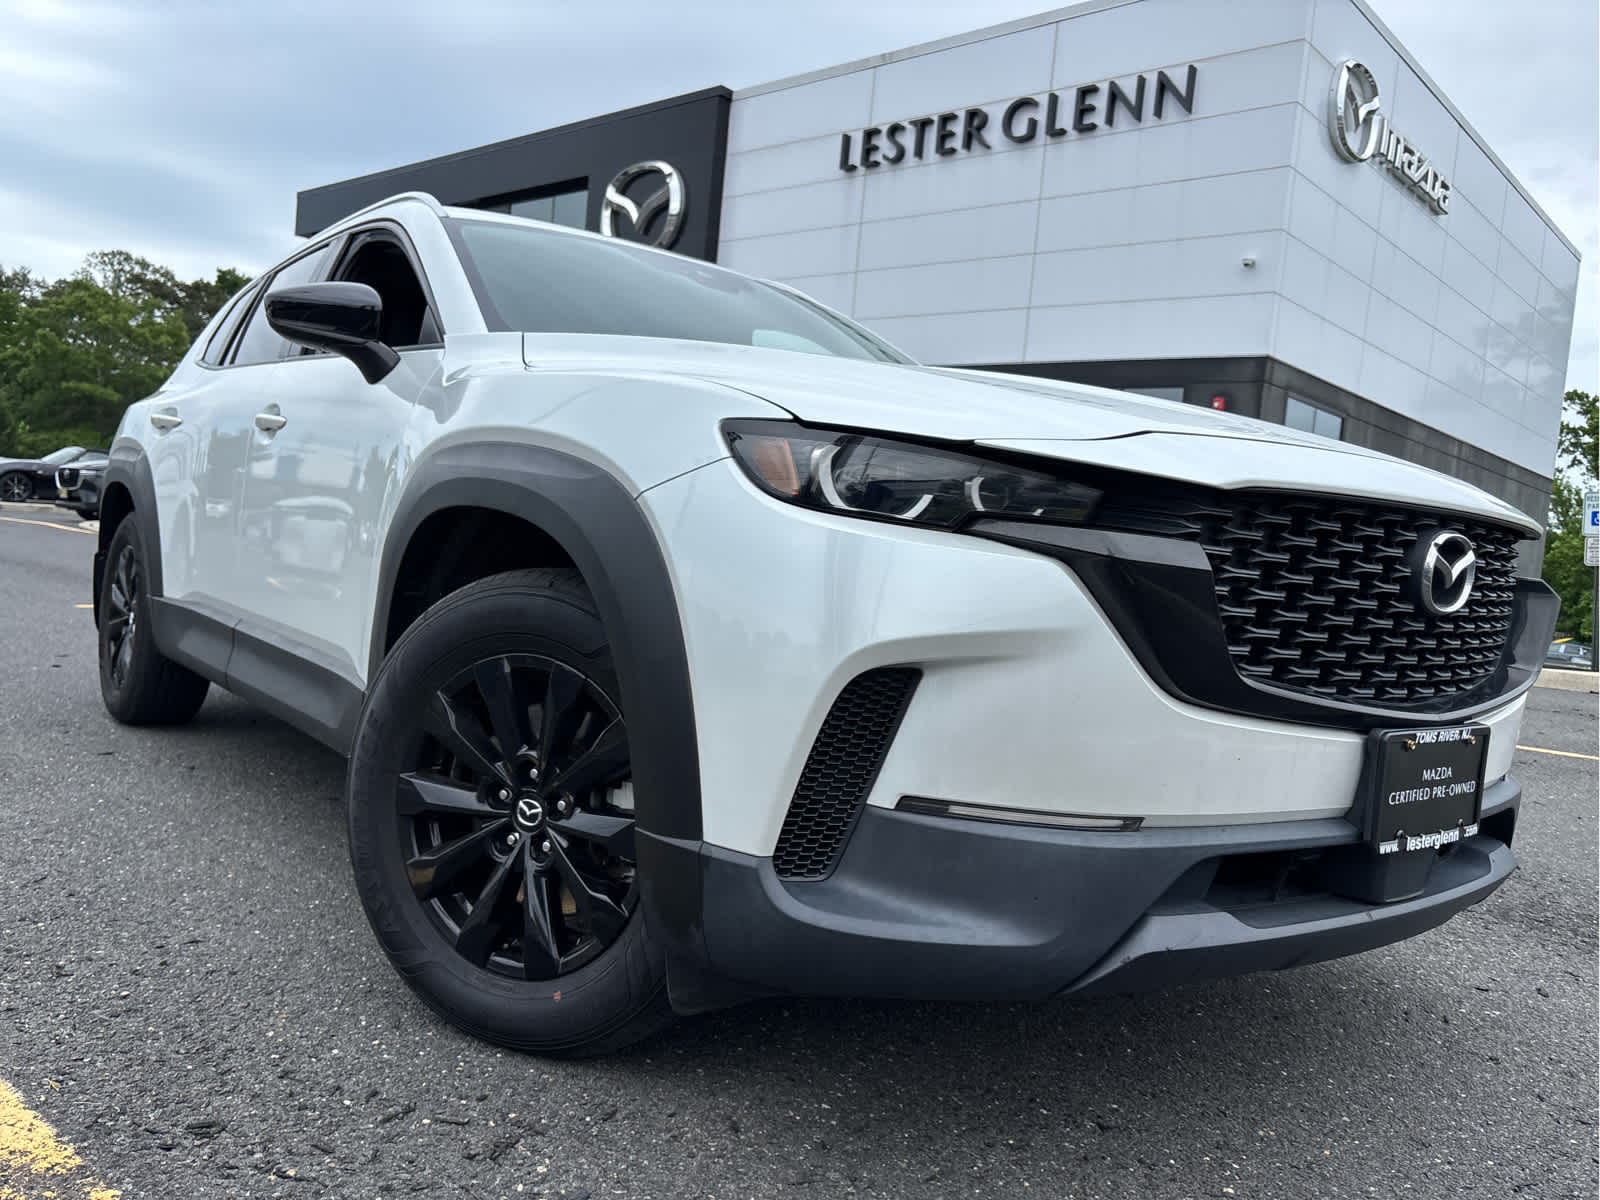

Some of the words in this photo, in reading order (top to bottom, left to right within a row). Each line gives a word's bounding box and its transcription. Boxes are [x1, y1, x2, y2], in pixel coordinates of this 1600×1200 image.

[839, 107, 992, 172] LESTER
[1001, 63, 1199, 145] GLENN
[1415, 731, 1438, 744] TOMS
[1422, 766, 1453, 782] MAZDA
[1388, 787, 1431, 805] CERTIFIED
[1432, 780, 1477, 799] PRE-OWNED
